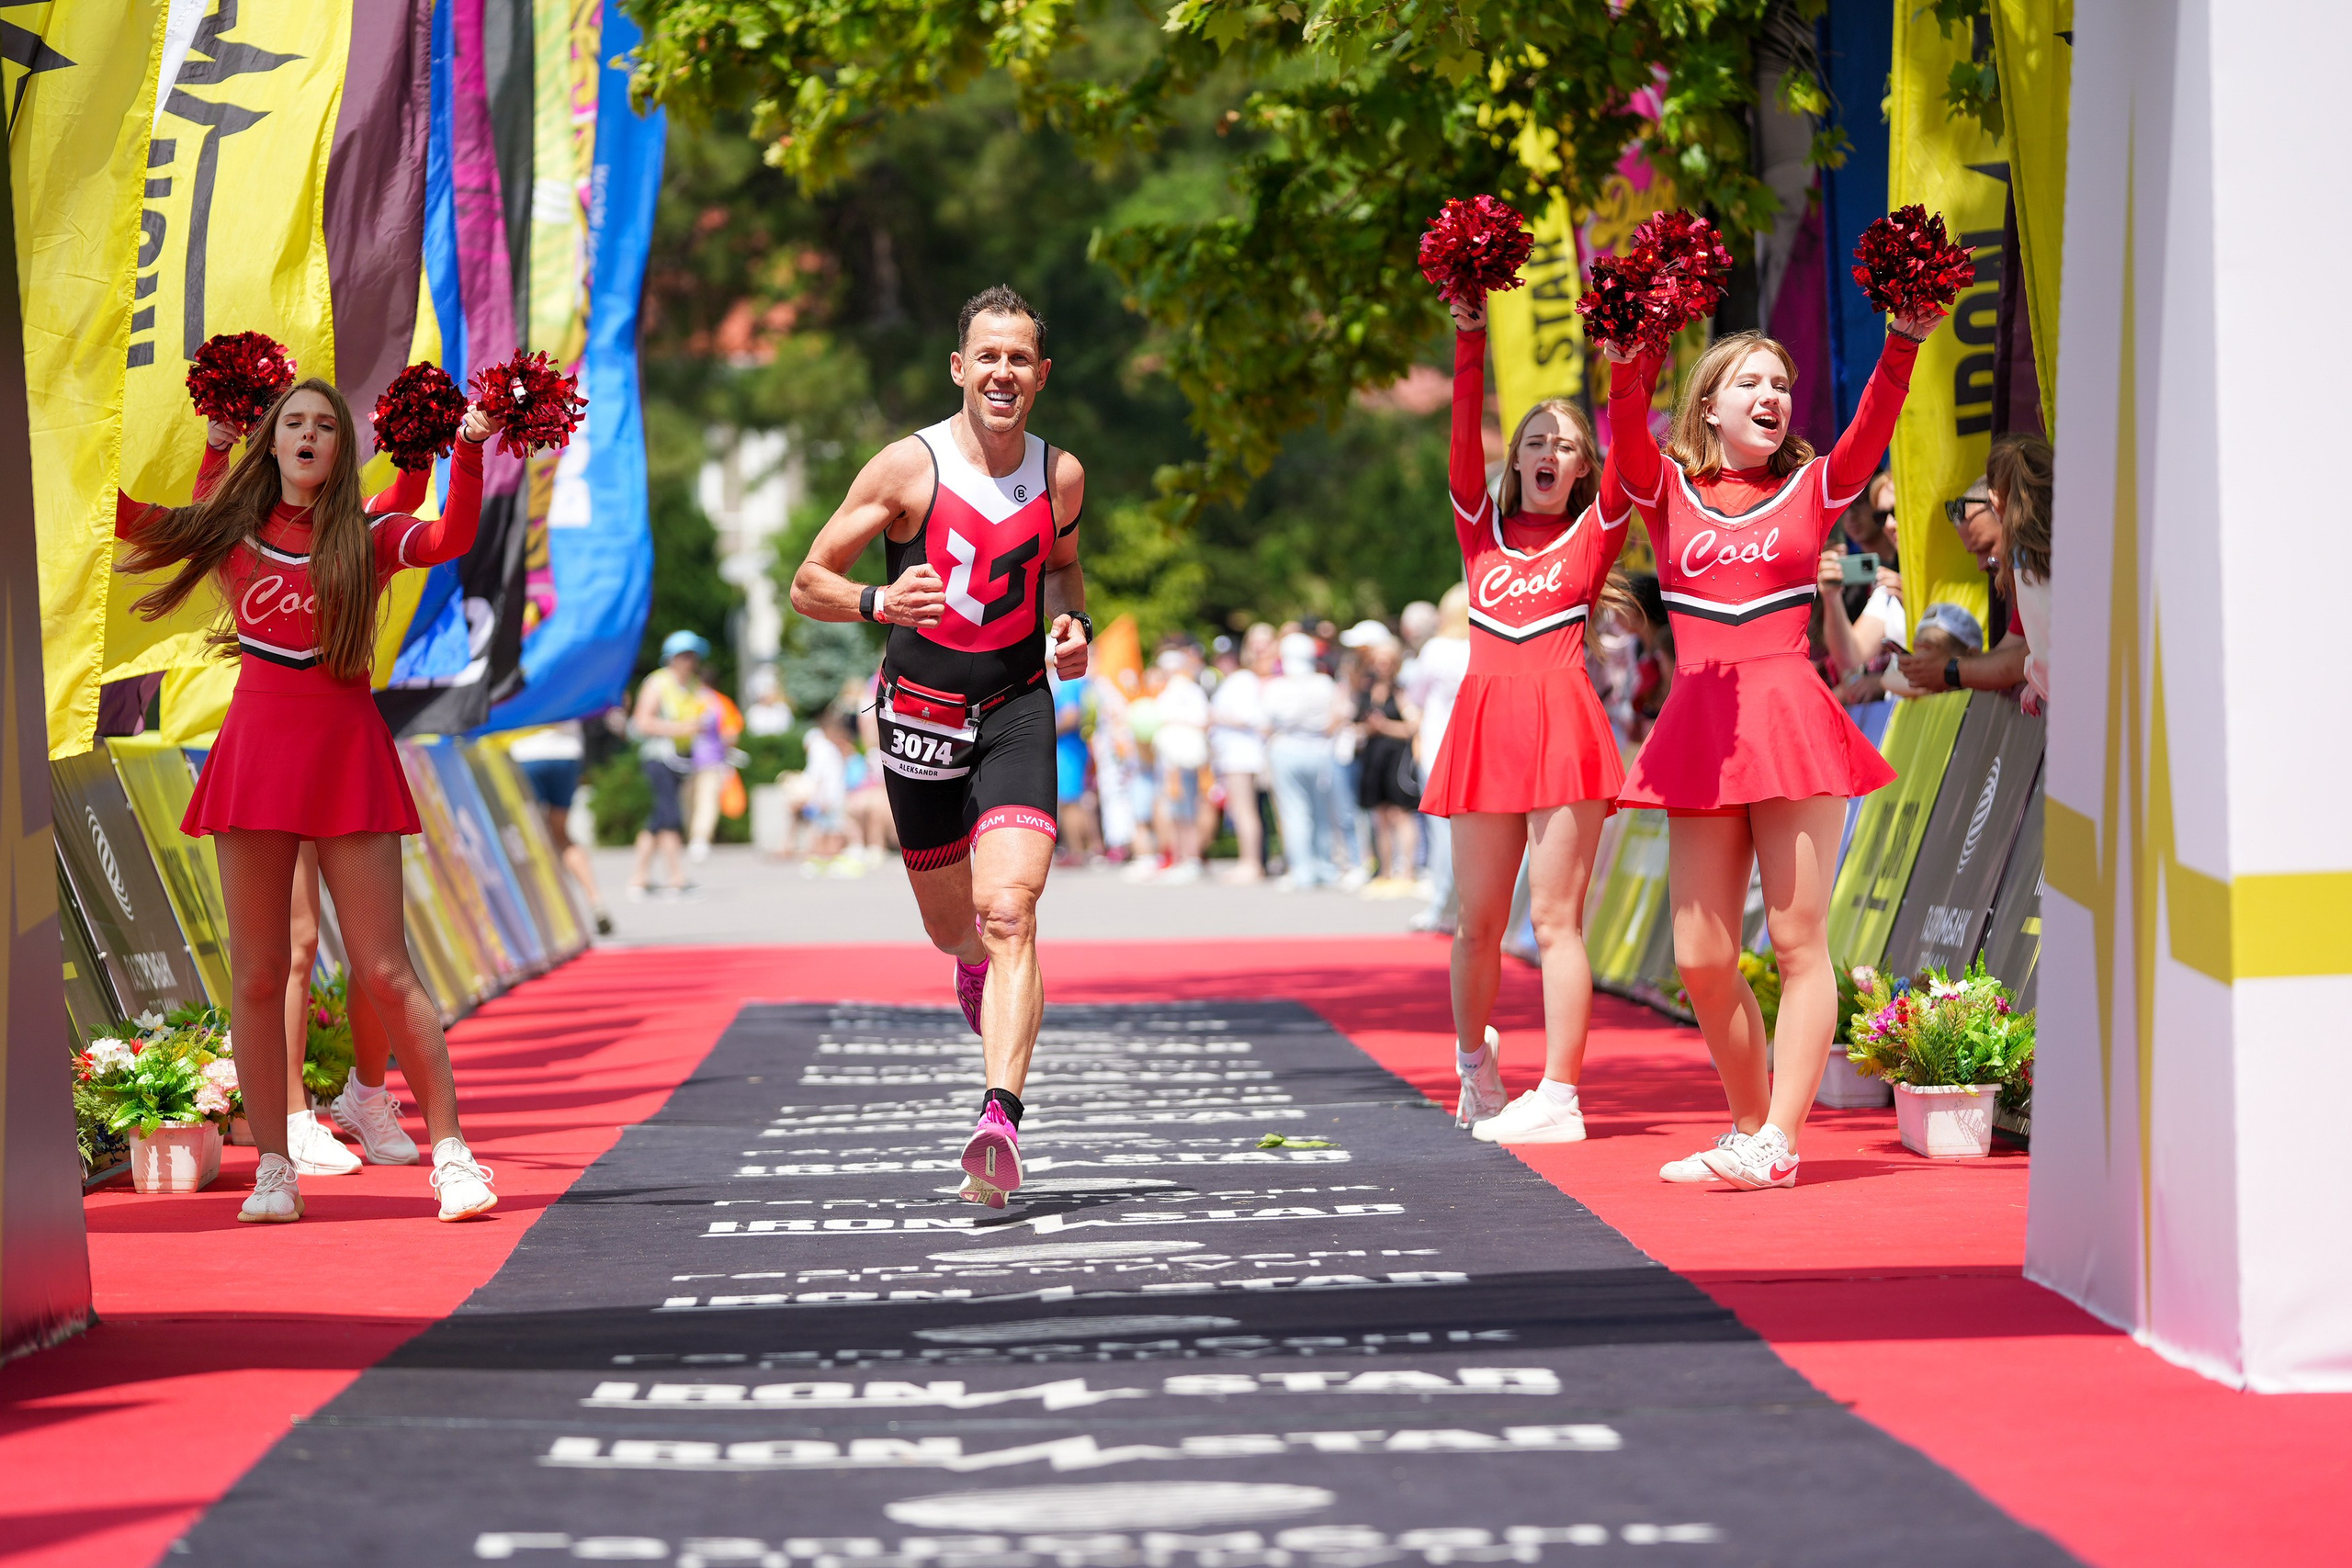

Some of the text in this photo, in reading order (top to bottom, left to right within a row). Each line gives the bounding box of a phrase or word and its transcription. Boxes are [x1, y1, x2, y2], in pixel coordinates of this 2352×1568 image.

[1529, 236, 1574, 366] STAR
[1680, 527, 1780, 578] Cool
[1478, 560, 1563, 607] Cool
[980, 694, 1005, 712] IRONMAN
[890, 728, 954, 765] 3074
[899, 763, 939, 777] ALEKSANDR
[978, 814, 1005, 832] TEAM
[739, 1150, 1351, 1174] IRON STAR
[708, 1203, 1406, 1233] IRON STAR
[662, 1271, 1469, 1308] IRON STAR
[591, 1367, 1560, 1403] IRON STAR
[548, 1423, 1623, 1466] IRON STAR
